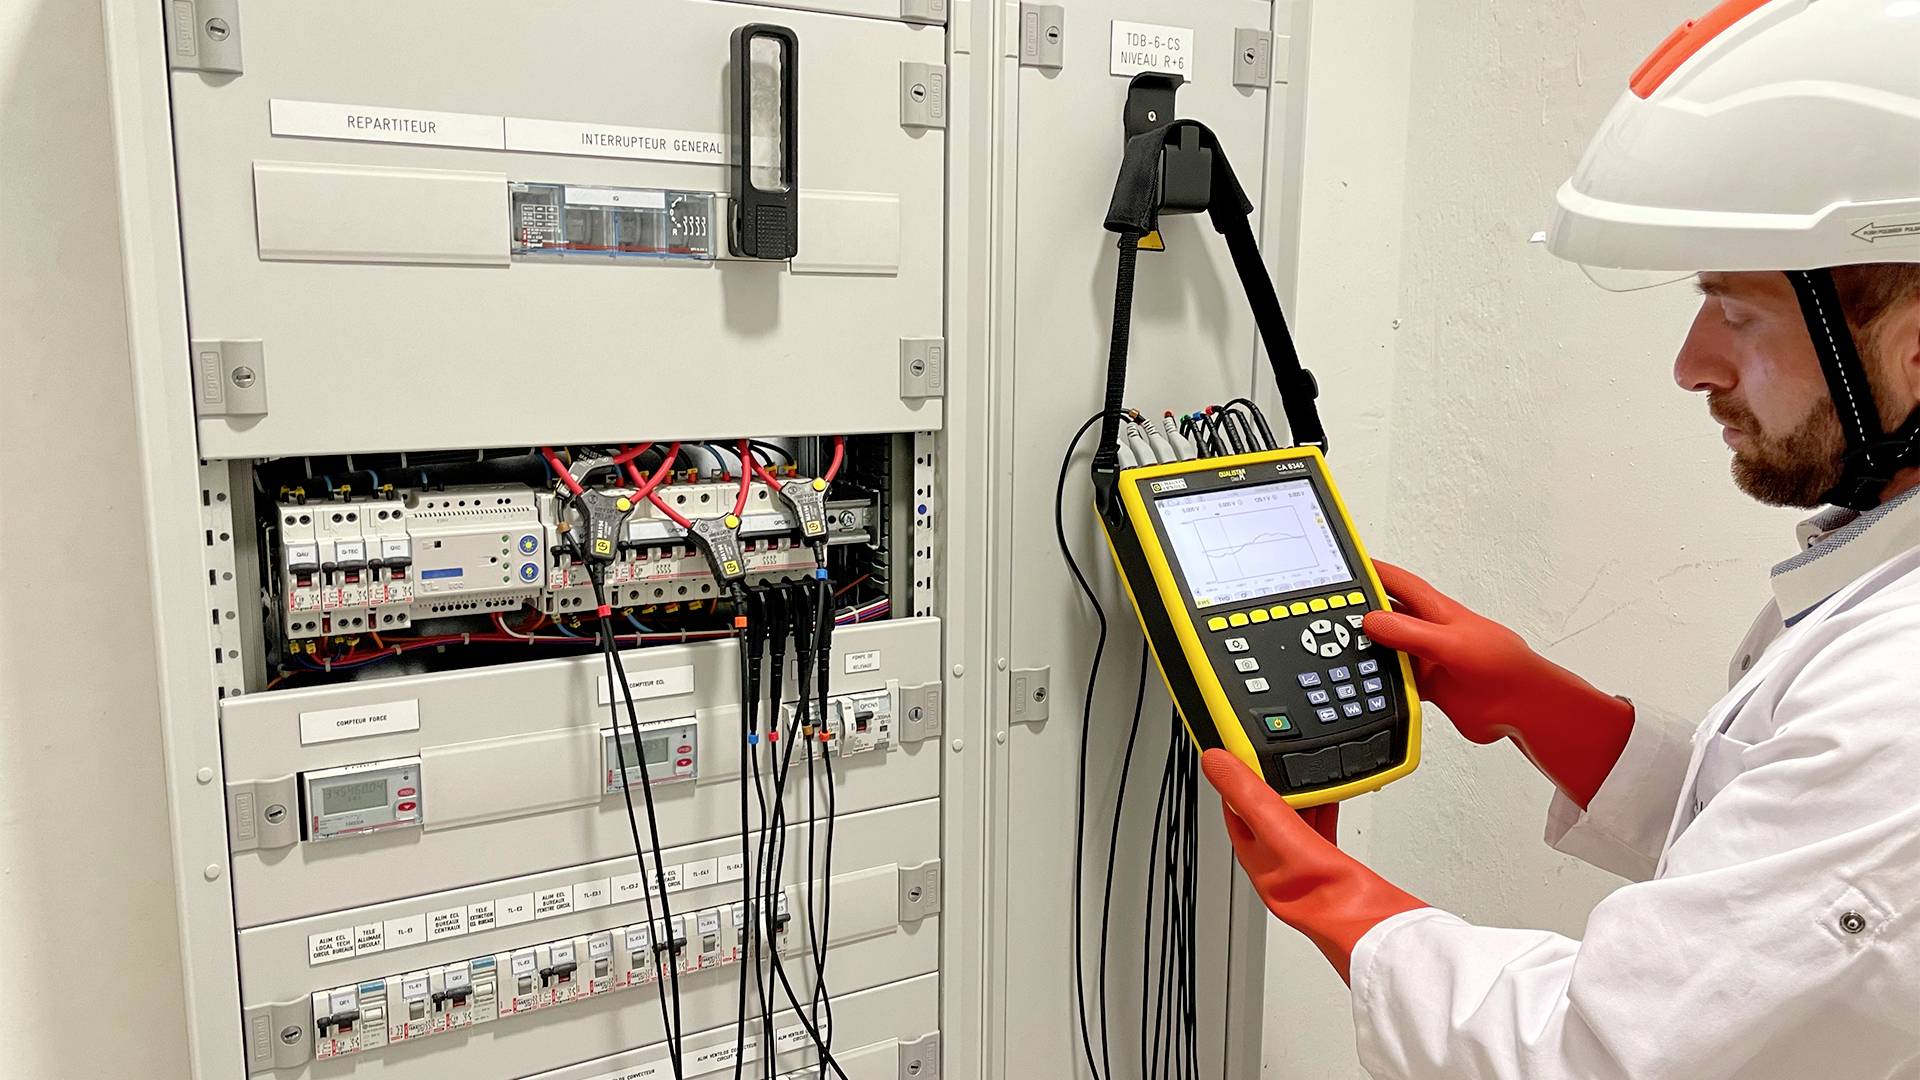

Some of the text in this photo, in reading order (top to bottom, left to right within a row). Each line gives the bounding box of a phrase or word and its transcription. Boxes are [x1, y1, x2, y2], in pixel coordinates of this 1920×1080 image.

[1121, 50, 1184, 69] NIVEAU R+6
[347, 116, 436, 134] REPARTITEUR
[581, 133, 723, 155] INTERRUPTEUR GENERAL
[629, 680, 654, 688] COMPTEUR
[1371, 699, 1381, 707] W
[1345, 706, 1359, 714] Wh
[336, 718, 366, 727] COMPTEUR
[542, 898, 565, 906] BUREAUX
[434, 914, 447, 922] ALIM
[435, 919, 459, 928] BUREAUX
[434, 924, 460, 935] CENTRAUX
[357, 933, 381, 943] ALLUMAGE
[313, 945, 353, 958] CIRCUL BUREAUX
[316, 944, 333, 952] LOCAL
[716, 1054, 733, 1062] CIRCUIT
[627, 1069, 655, 1079] CONVECTEUR
